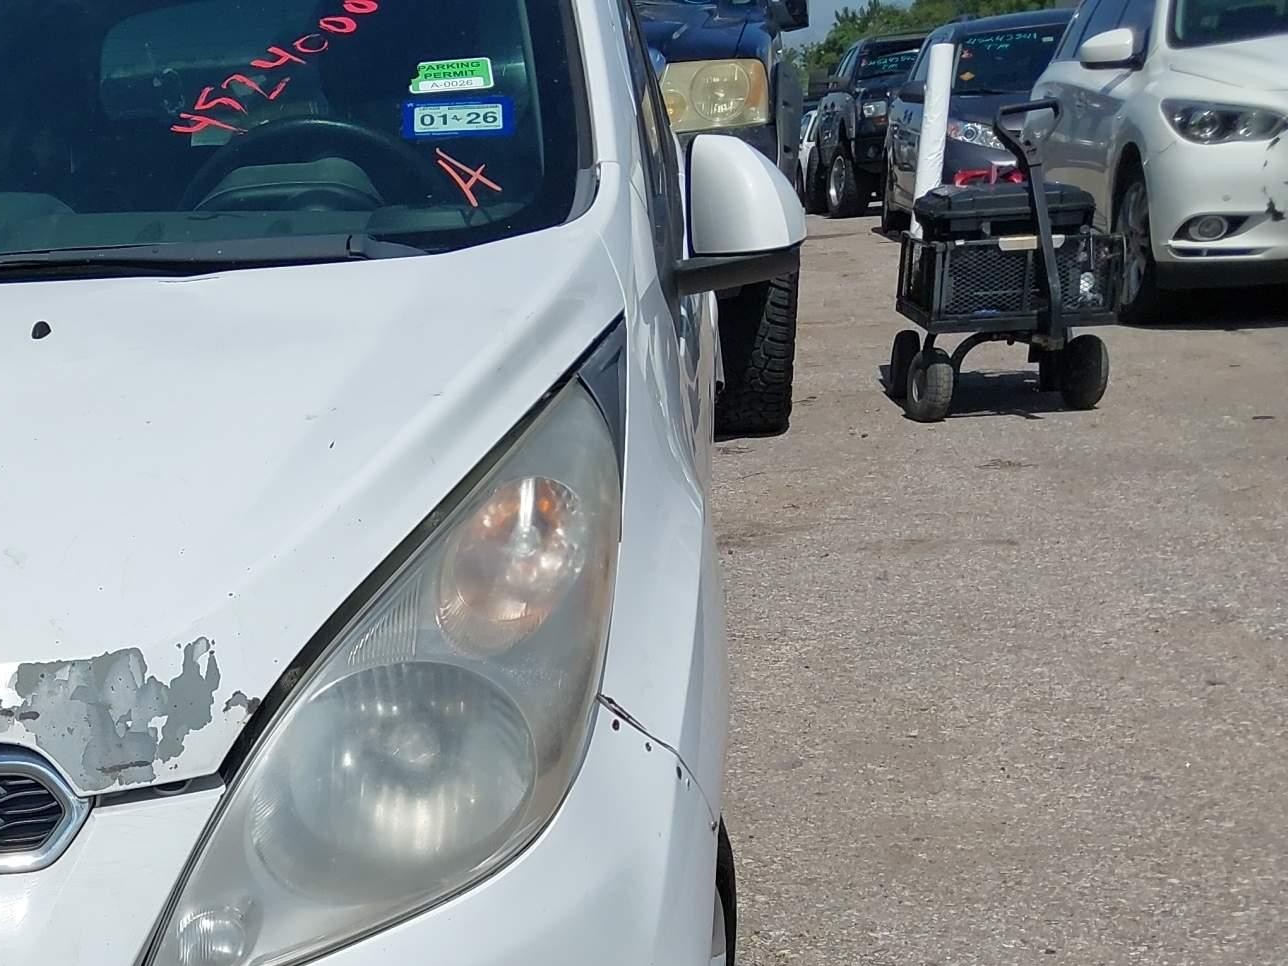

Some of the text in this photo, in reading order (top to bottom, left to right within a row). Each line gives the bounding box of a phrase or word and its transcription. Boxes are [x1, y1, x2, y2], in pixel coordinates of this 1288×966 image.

[418, 61, 481, 72] PARKING
[423, 69, 476, 80] PERMIT
[430, 79, 474, 89] A-0026
